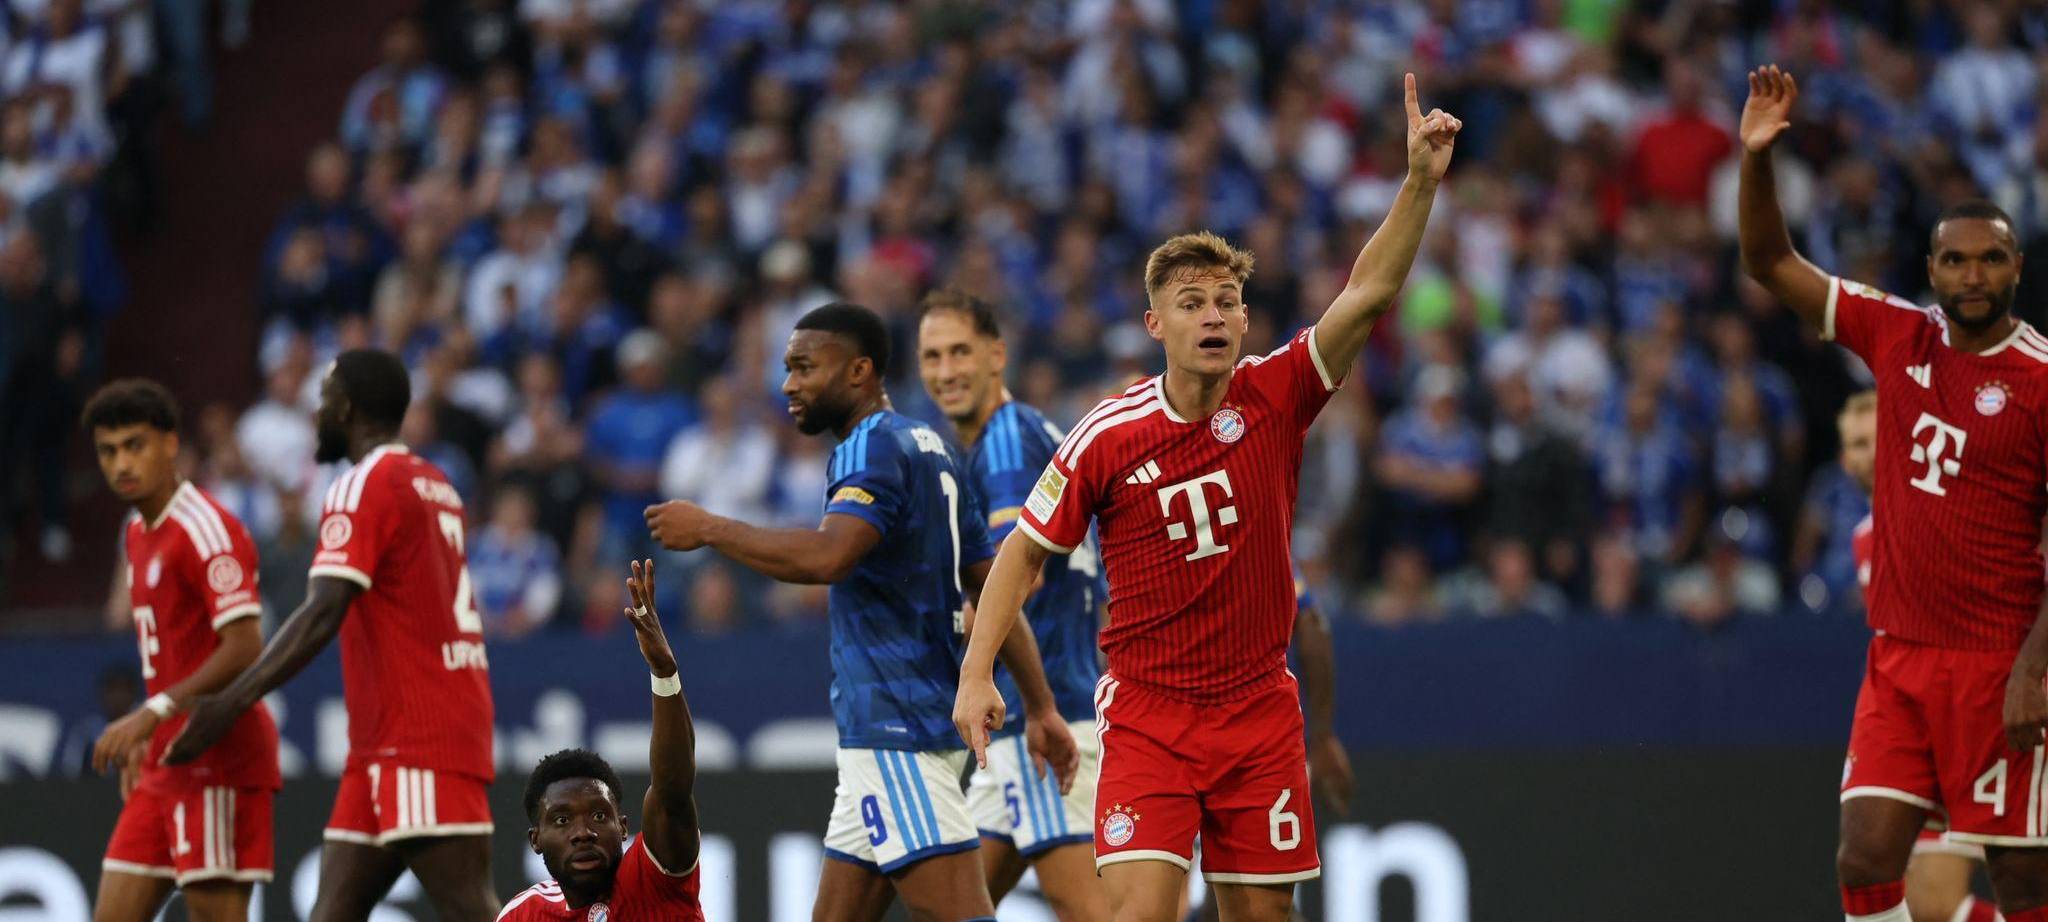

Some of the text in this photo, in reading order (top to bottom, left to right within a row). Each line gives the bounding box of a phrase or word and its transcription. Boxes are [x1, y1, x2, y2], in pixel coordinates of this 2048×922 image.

[1910, 411, 1967, 497] T
[1157, 468, 1238, 562] T
[1973, 758, 2008, 817] 4
[861, 794, 888, 847] 9
[1269, 788, 1301, 851] 6
